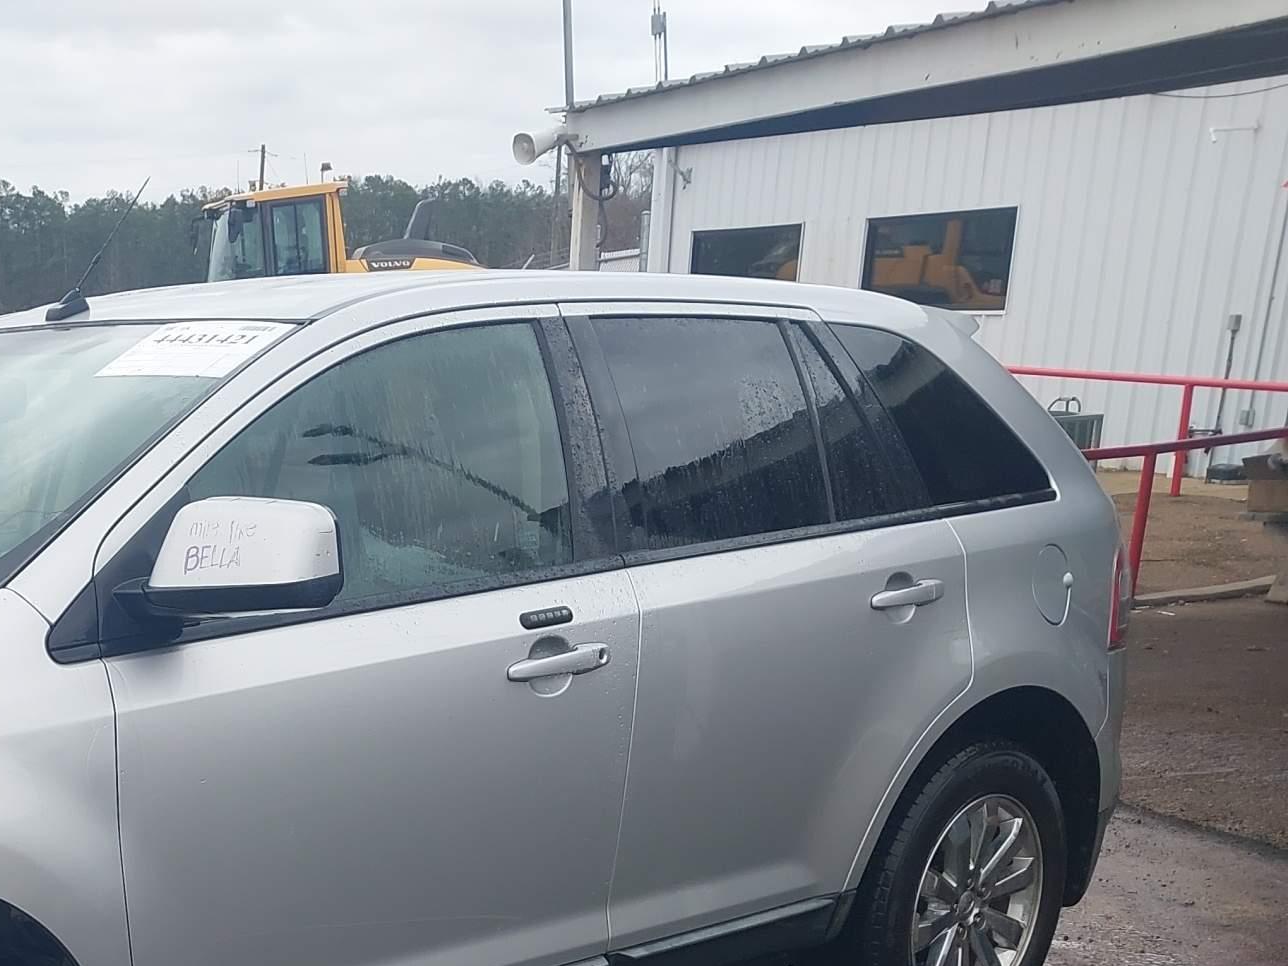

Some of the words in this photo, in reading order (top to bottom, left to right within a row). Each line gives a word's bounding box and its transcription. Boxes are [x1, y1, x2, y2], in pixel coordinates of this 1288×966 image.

[371, 260, 411, 269] VOLVO
[153, 334, 260, 345] 44431421
[184, 544, 241, 576] BELLA
